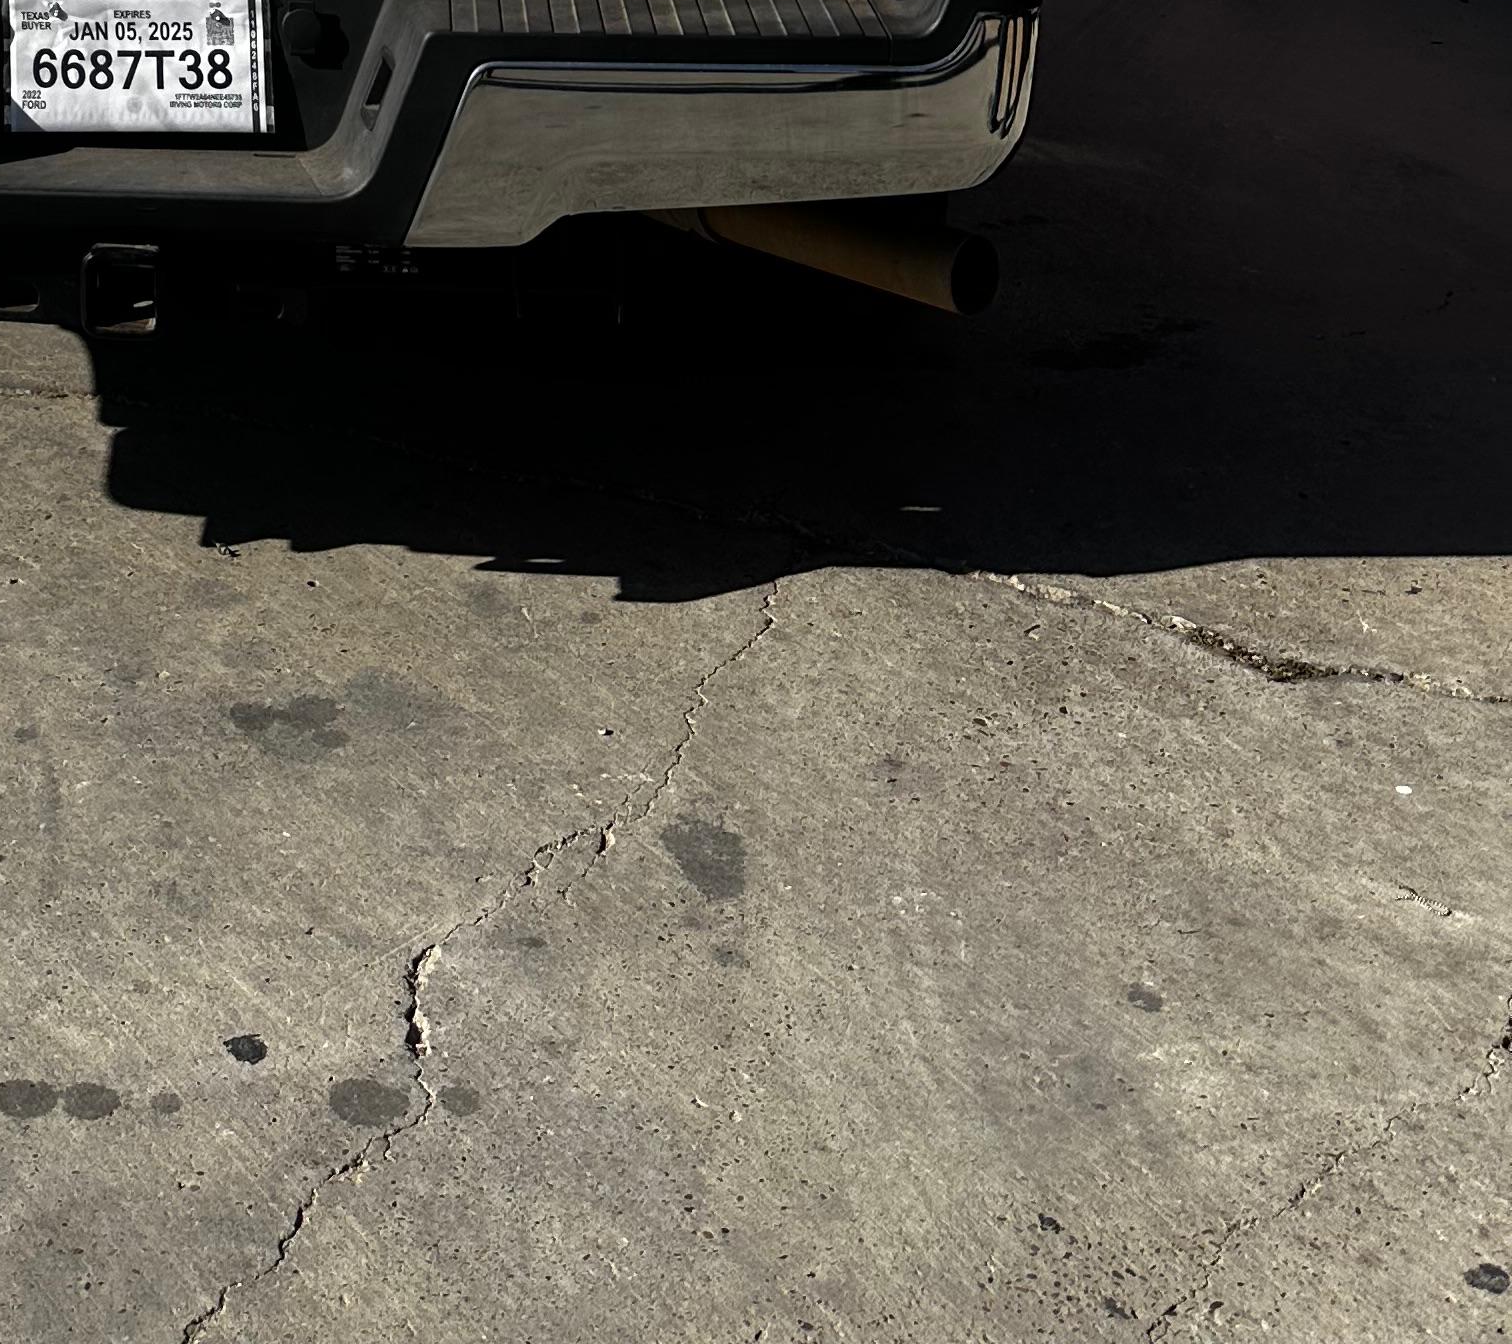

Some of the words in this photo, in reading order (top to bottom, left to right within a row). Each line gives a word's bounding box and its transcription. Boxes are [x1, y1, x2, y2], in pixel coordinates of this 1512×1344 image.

[21, 10, 50, 21] TEXAS
[113, 9, 152, 20] EXPIRES
[21, 20, 52, 31] BUYER
[69, 21, 109, 42] JAN
[115, 21, 143, 44] 05,
[148, 21, 194, 41] 2025
[32, 48, 234, 90] 6687T38
[21, 99, 47, 110] FORD
